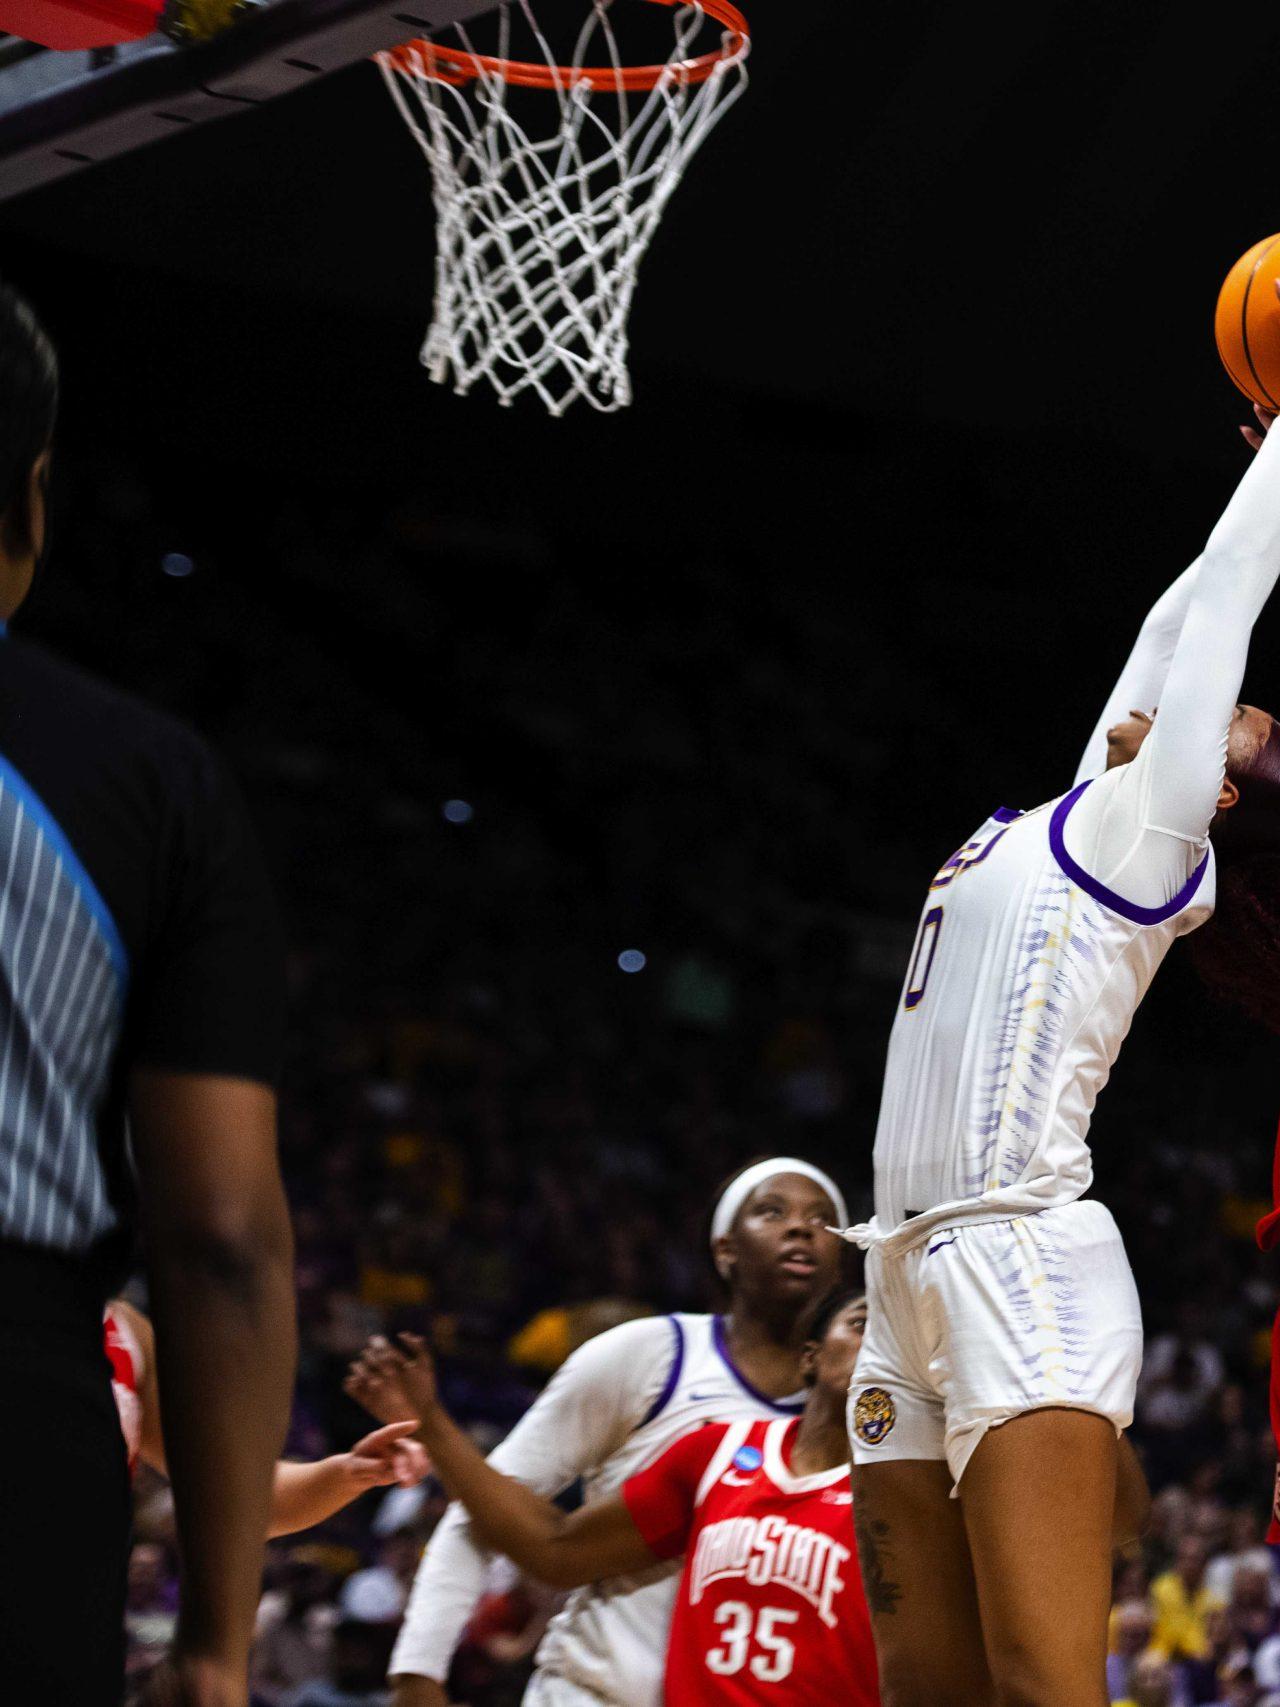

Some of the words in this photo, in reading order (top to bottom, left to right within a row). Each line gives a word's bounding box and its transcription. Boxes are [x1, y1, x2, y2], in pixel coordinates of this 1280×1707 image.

[904, 905, 945, 1012] 0
[745, 1514, 851, 1629] STATE
[705, 1599, 799, 1683] 35
